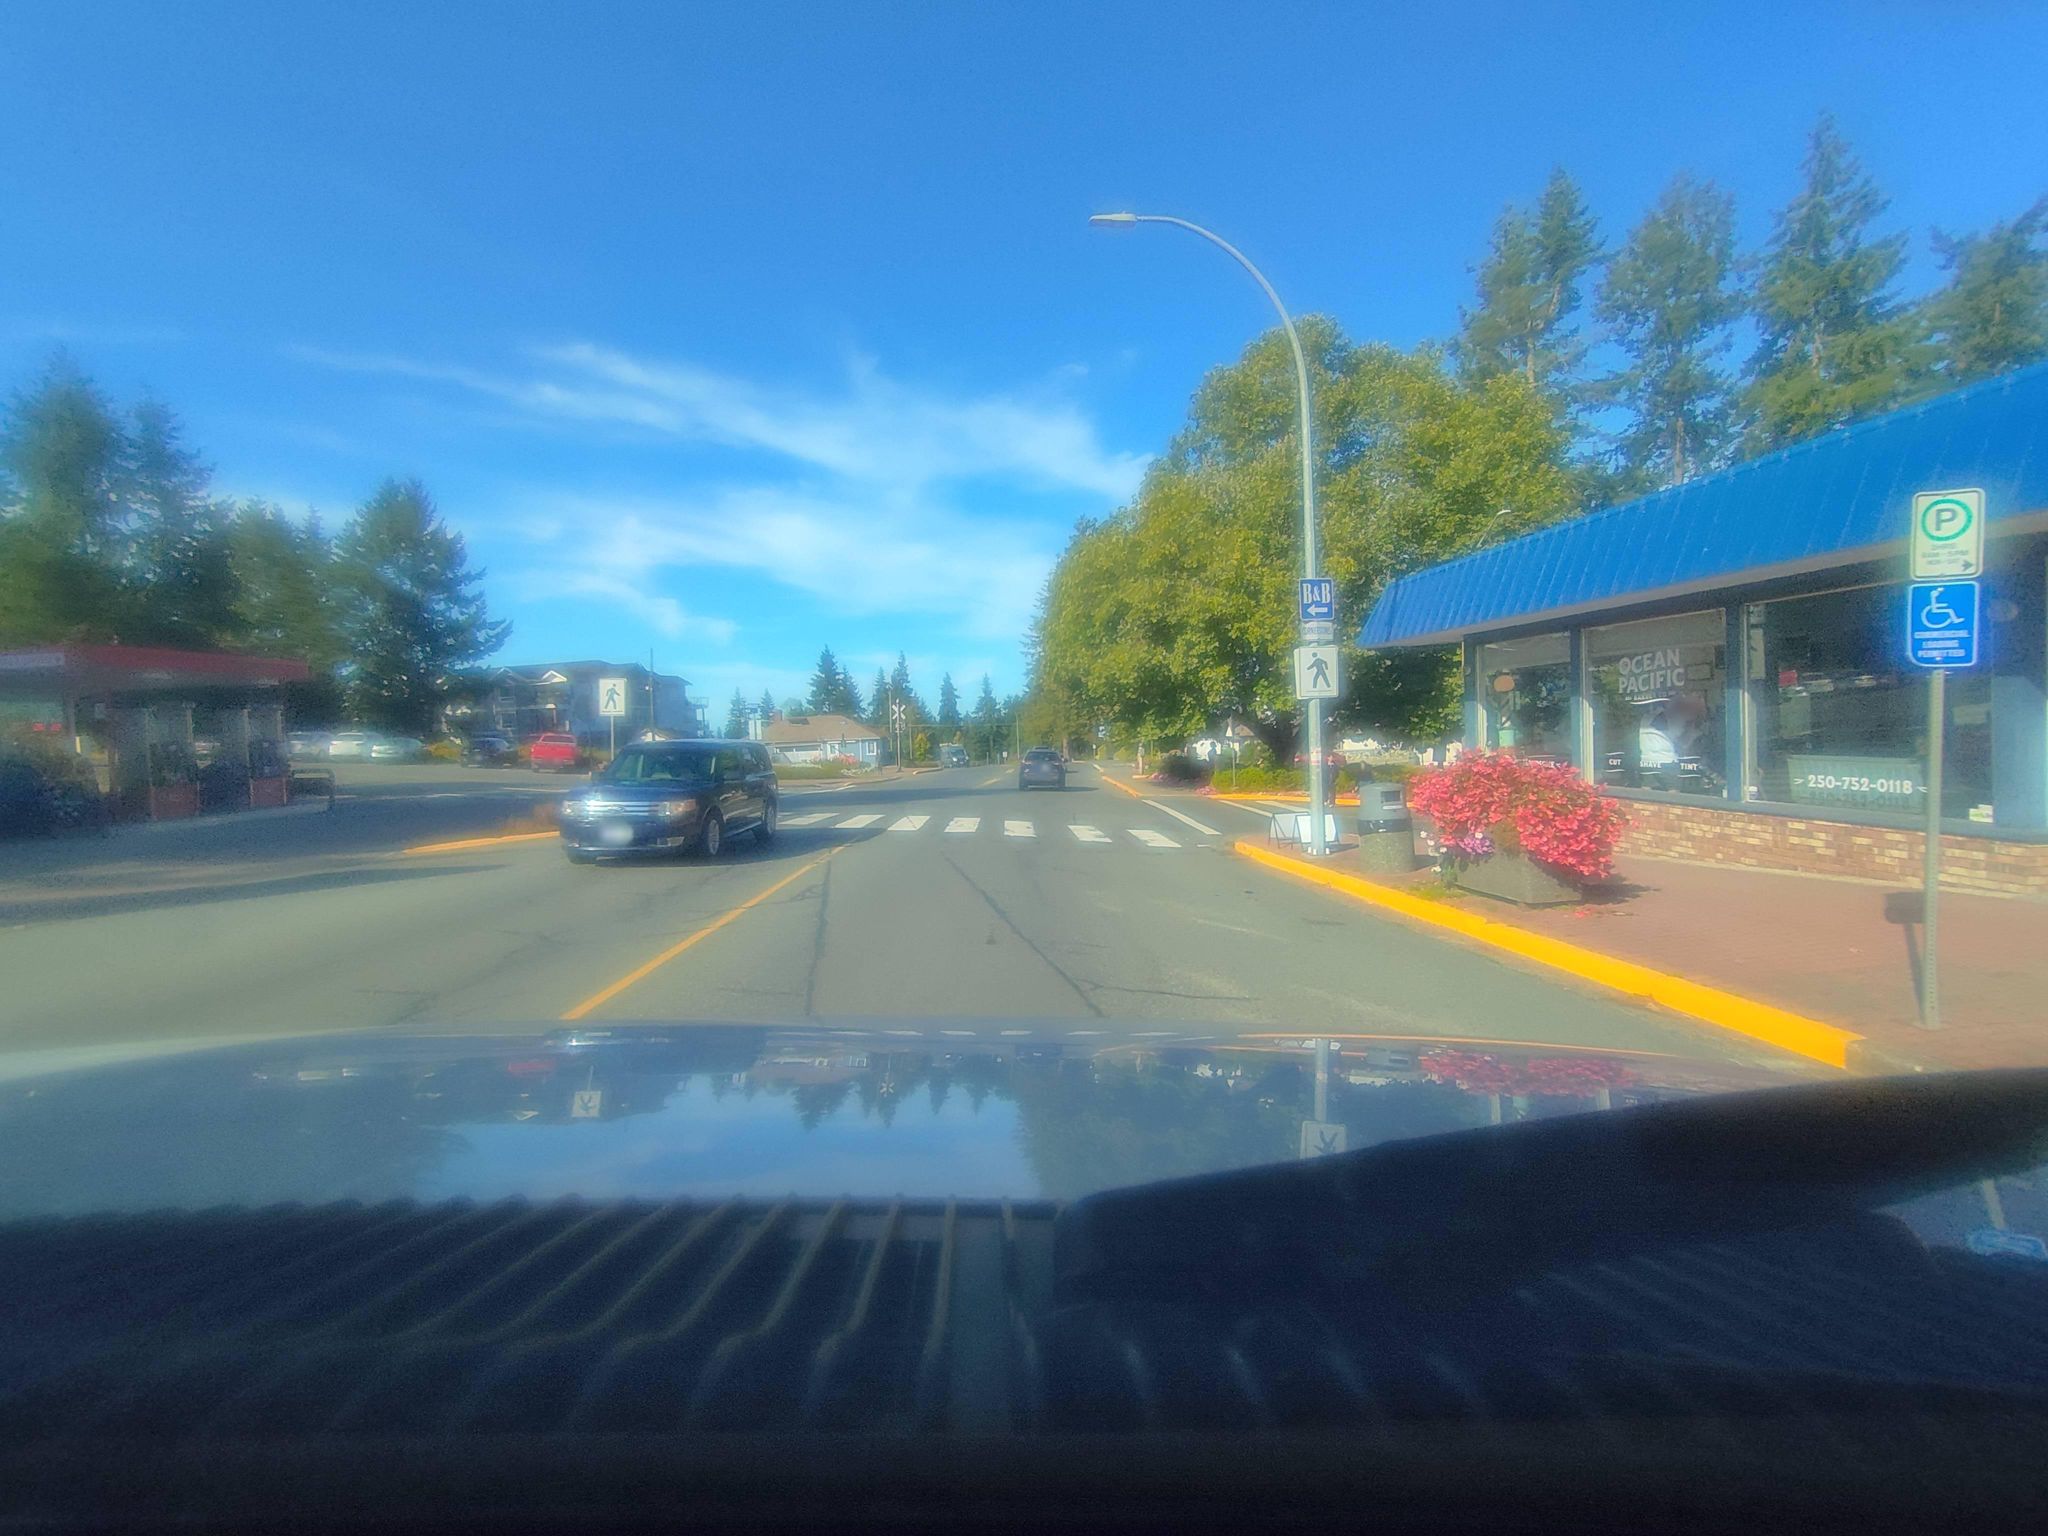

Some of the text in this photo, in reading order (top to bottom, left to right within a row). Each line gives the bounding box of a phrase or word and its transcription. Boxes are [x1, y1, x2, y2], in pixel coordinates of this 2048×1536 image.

[1935, 508, 1957, 531] P
[1302, 583, 1331, 604] B&B
[1619, 648, 1680, 675] OCEAN
[1618, 668, 1685, 694] PACIFIC
[1640, 760, 1662, 769] SHAVE
[1680, 763, 1698, 771] TINT
[1808, 774, 1913, 795] 250-752-0118
